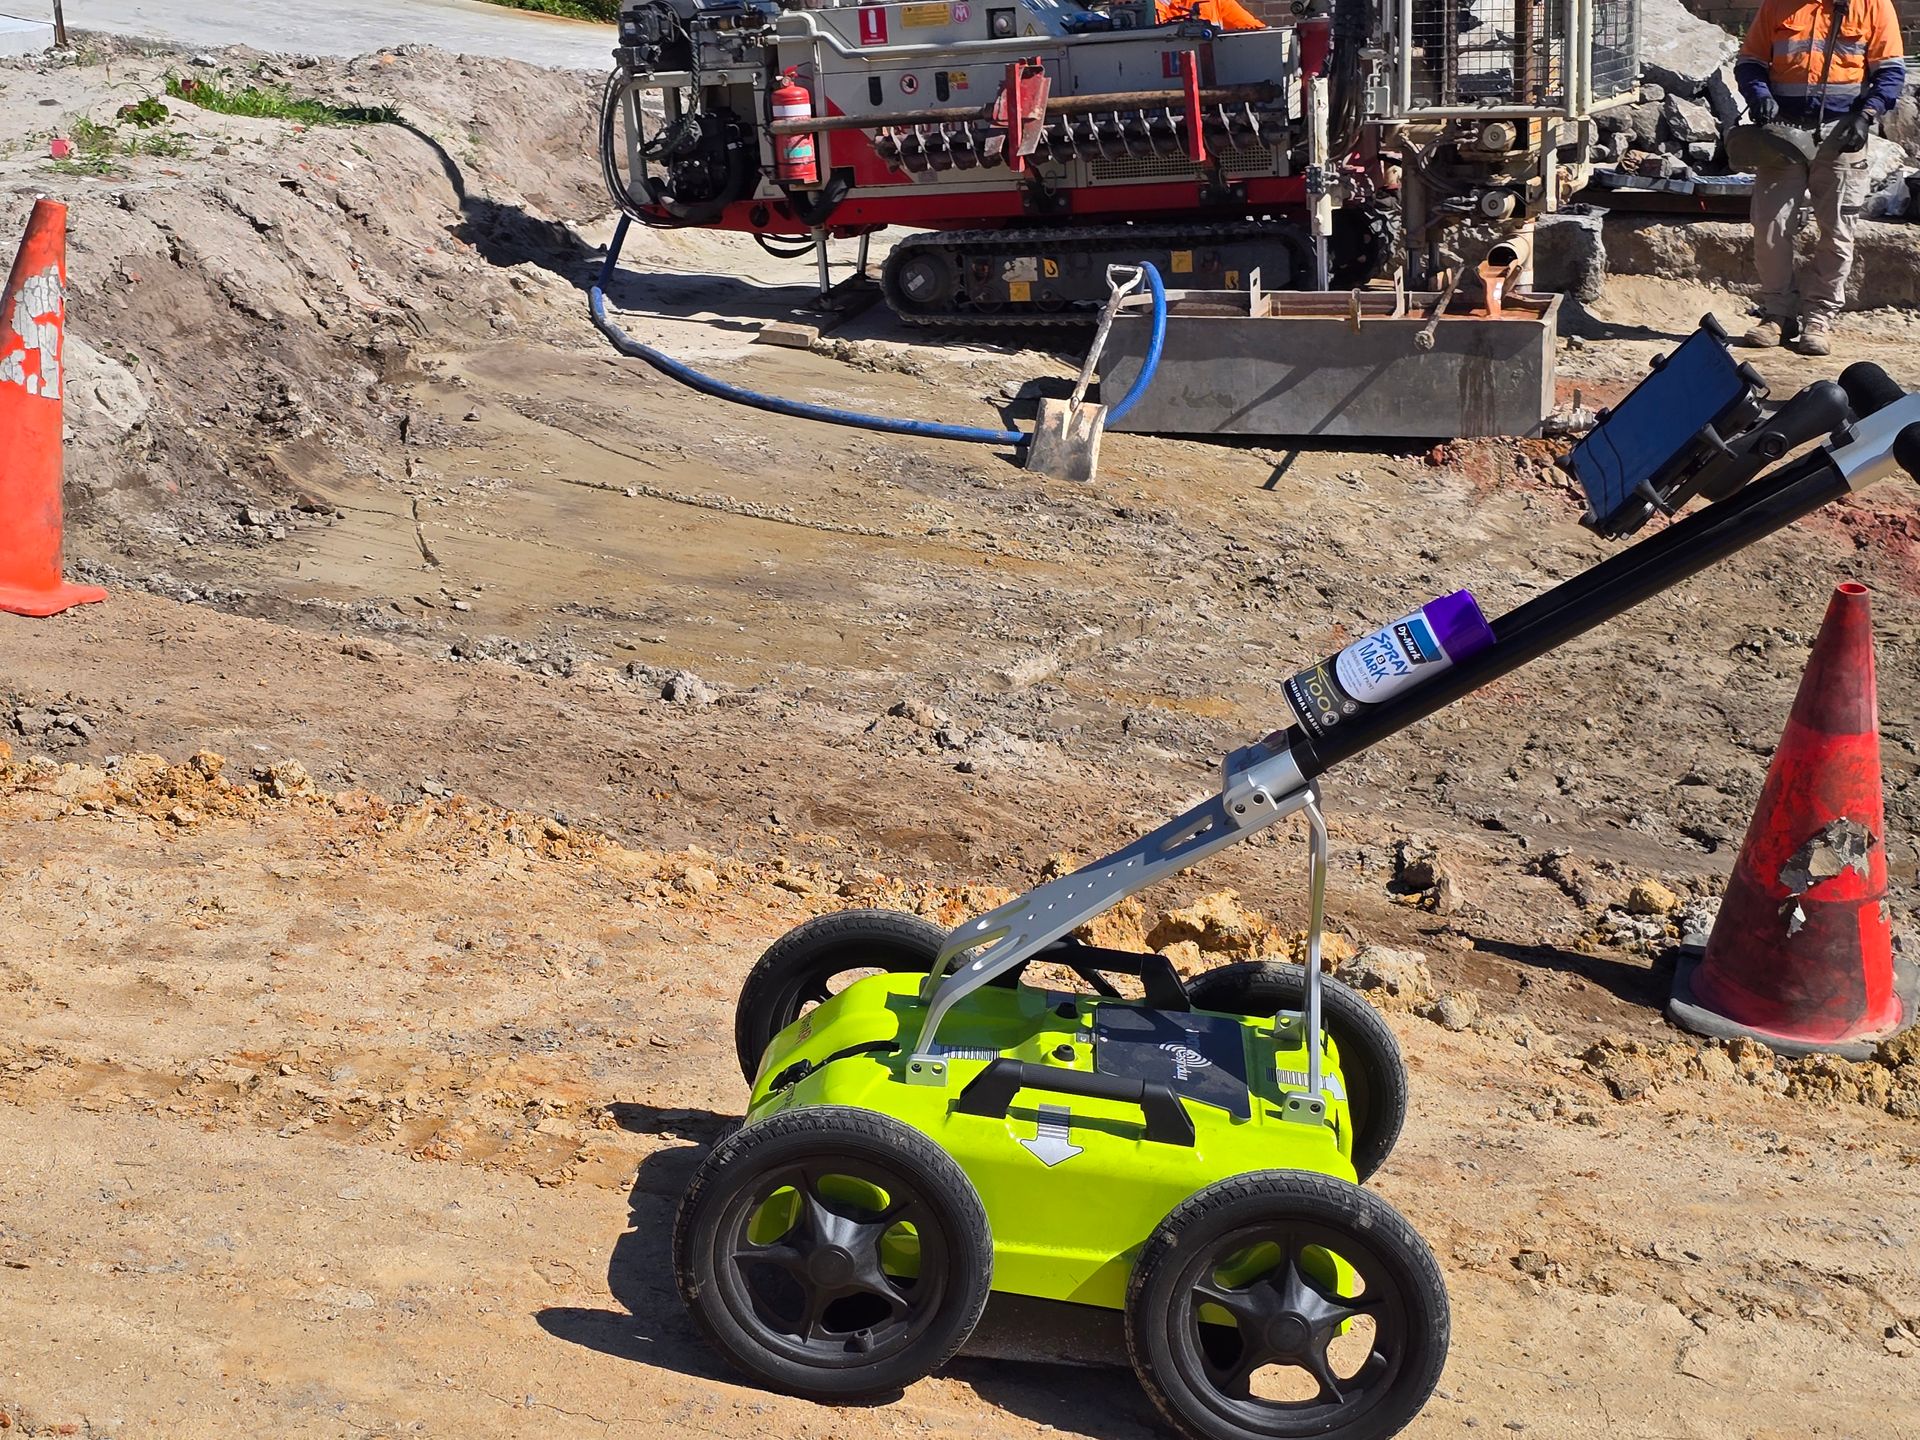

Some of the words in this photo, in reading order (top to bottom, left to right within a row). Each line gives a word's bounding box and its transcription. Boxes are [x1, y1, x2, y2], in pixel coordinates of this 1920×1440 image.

[1370, 632, 1413, 677] SPRAY
[1397, 625, 1421, 661] Dy-Mark
[1358, 642, 1390, 684] MARK
[1304, 675, 1332, 712] 100
